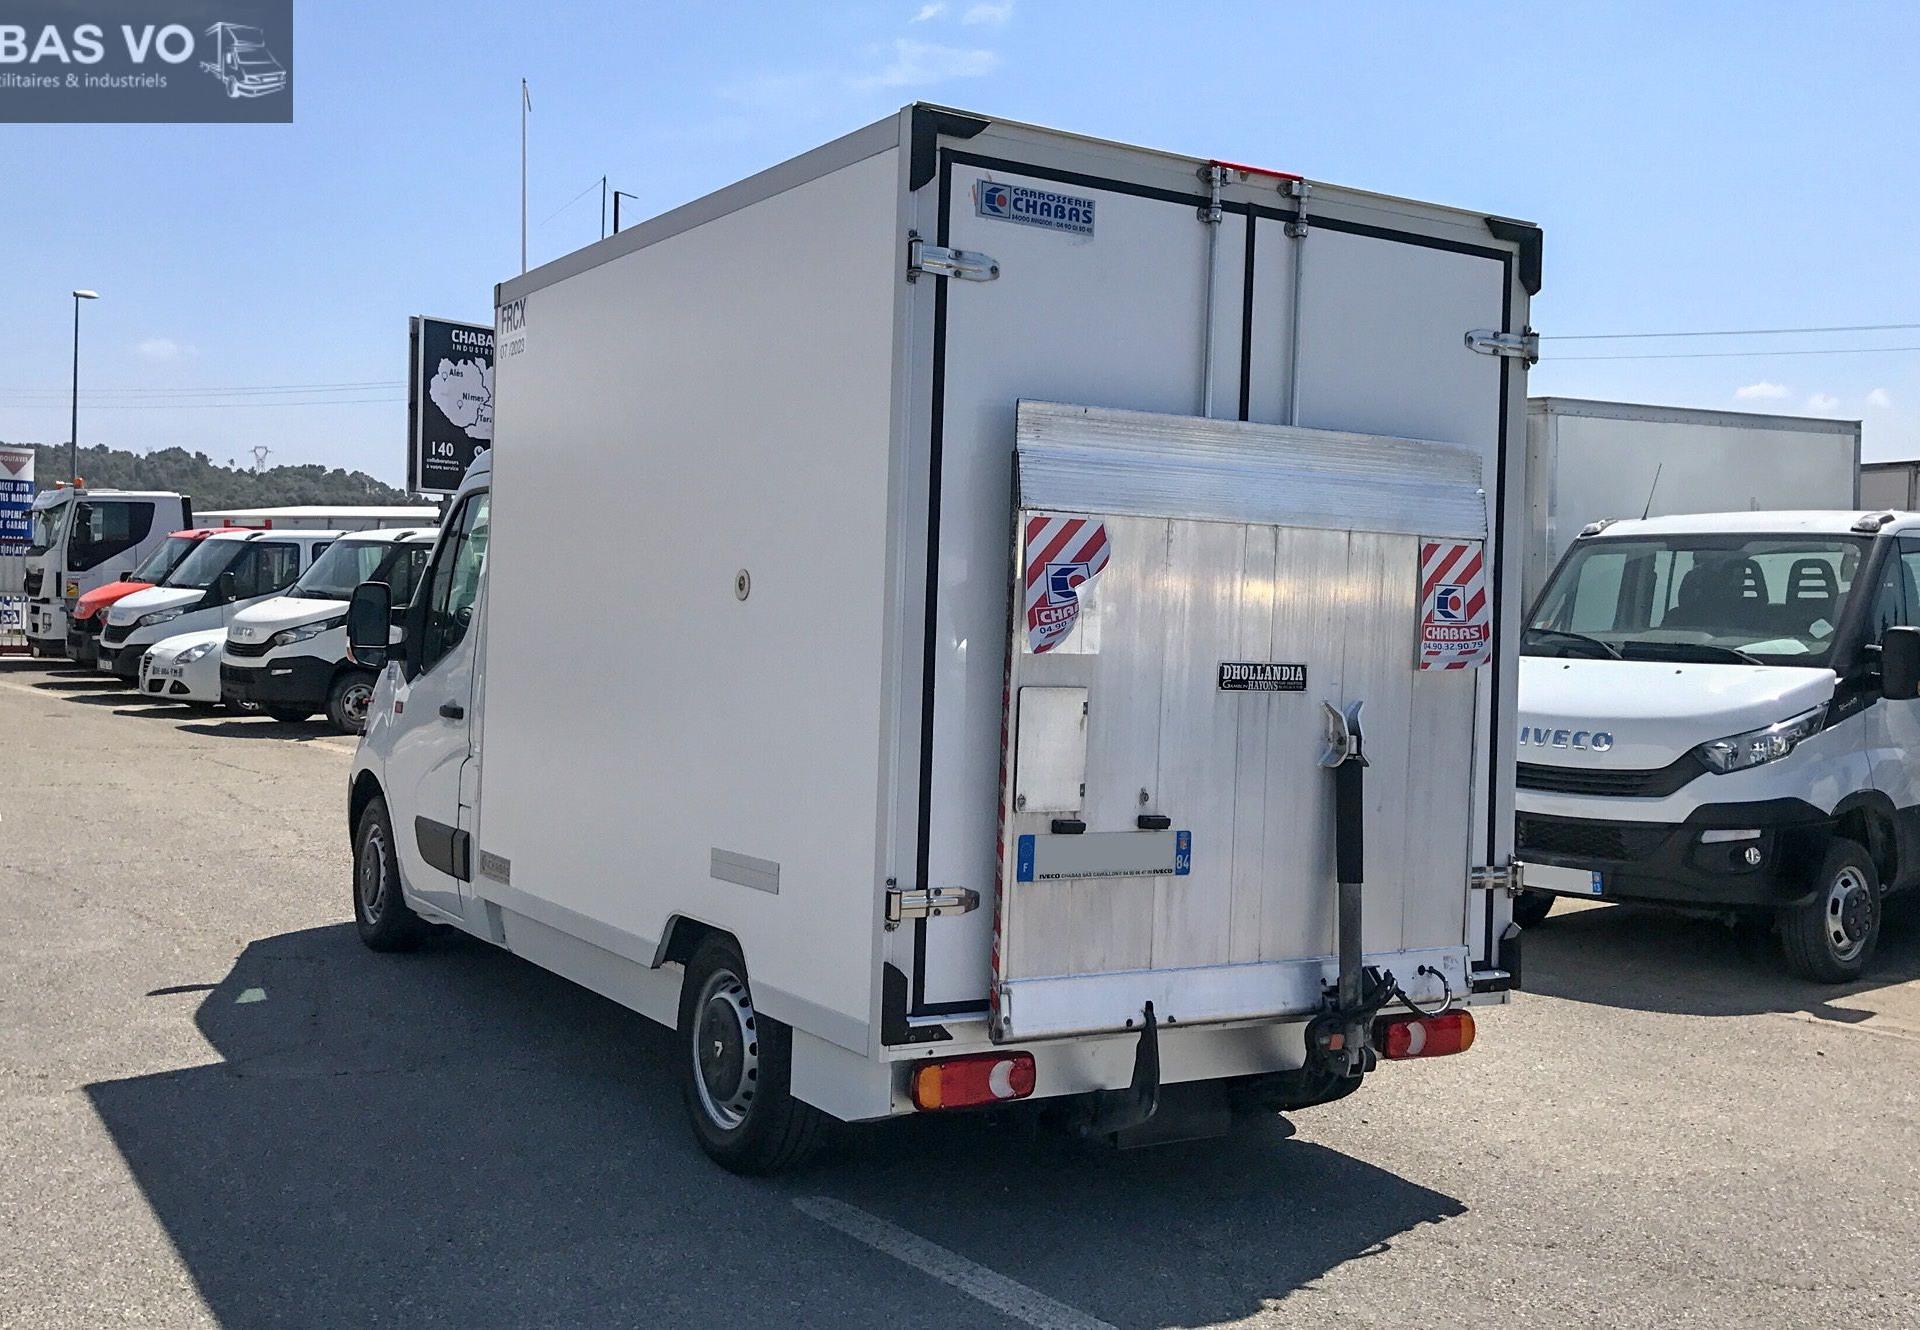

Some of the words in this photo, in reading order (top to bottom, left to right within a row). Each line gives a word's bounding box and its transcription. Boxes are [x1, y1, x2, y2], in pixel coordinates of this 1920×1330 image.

[1013, 187, 1093, 210] CARROSSERIE
[1012, 197, 1093, 225] CHABAS
[501, 297, 526, 335] FRCX
[432, 441, 454, 457] 140
[1425, 627, 1480, 640] CHABAS
[1423, 640, 1484, 651] 04.90.32.90.79
[1222, 665, 1304, 681] DHOLLANDIA
[1519, 726, 1614, 753] IVECO
[1023, 862, 1029, 873] F
[1176, 854, 1190, 870] 84
